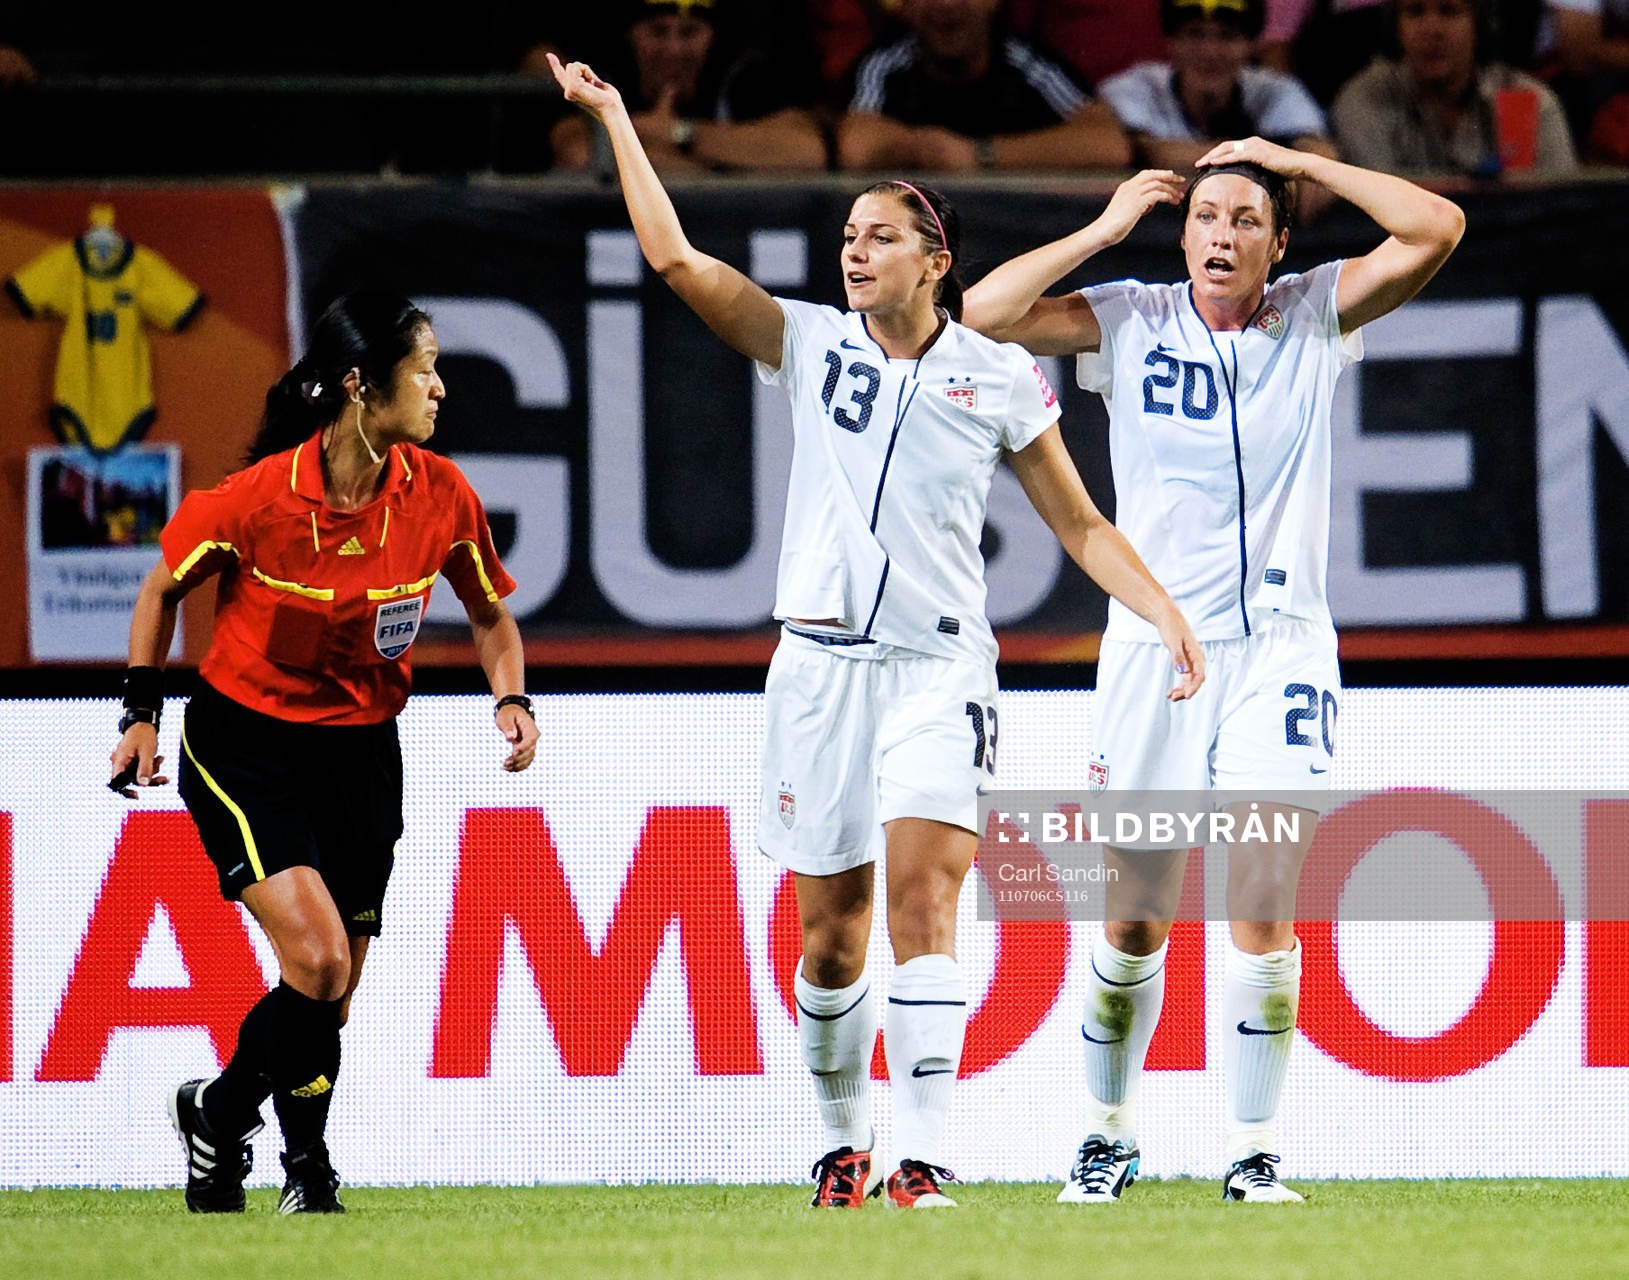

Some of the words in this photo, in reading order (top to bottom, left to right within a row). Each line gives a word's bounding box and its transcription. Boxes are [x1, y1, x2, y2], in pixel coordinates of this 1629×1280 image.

[821, 349, 881, 433] 13
[1142, 350, 1218, 420] 20
[381, 601, 420, 617] REFEREE
[381, 620, 415, 639] FIFA
[966, 701, 998, 777] 13
[1283, 683, 1337, 757] 20
